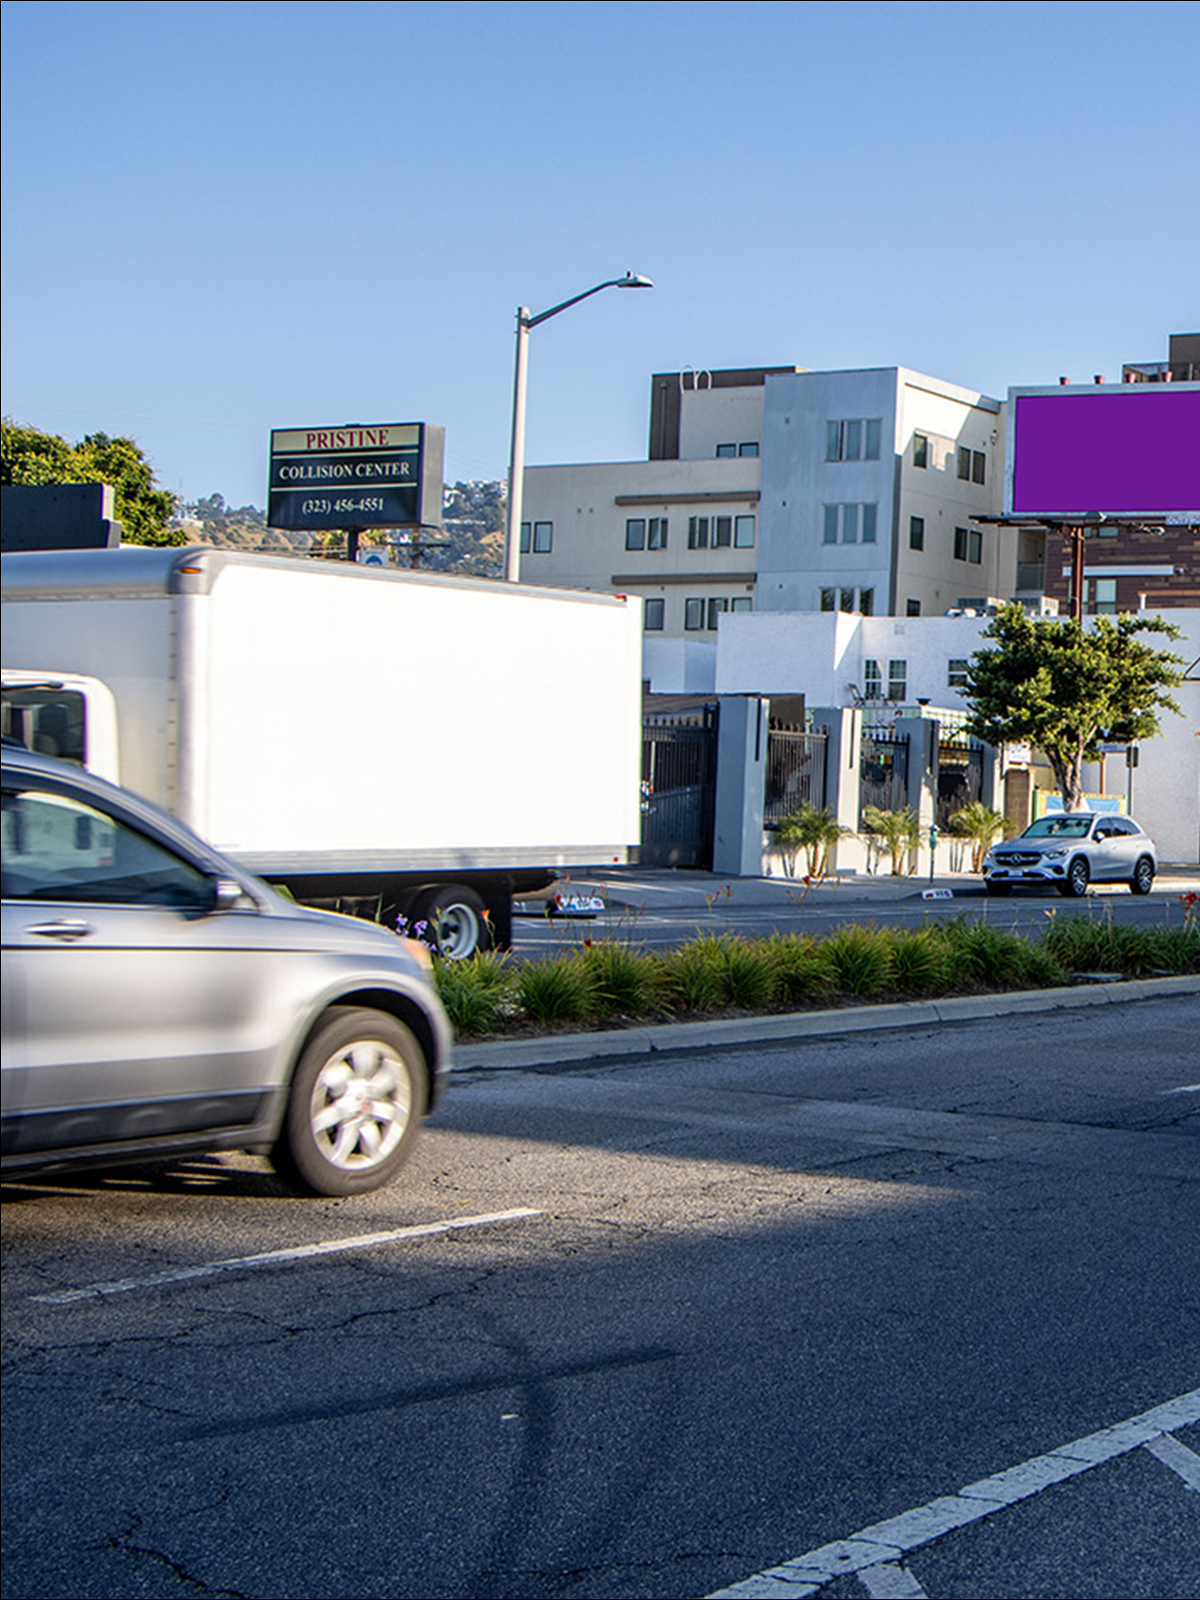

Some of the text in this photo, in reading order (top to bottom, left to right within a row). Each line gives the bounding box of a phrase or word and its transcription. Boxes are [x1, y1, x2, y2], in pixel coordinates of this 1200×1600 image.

[306, 429, 390, 449] PRISTINE
[279, 461, 410, 480] COLLISION CENTER
[302, 498, 384, 515] (323) 456-4551
